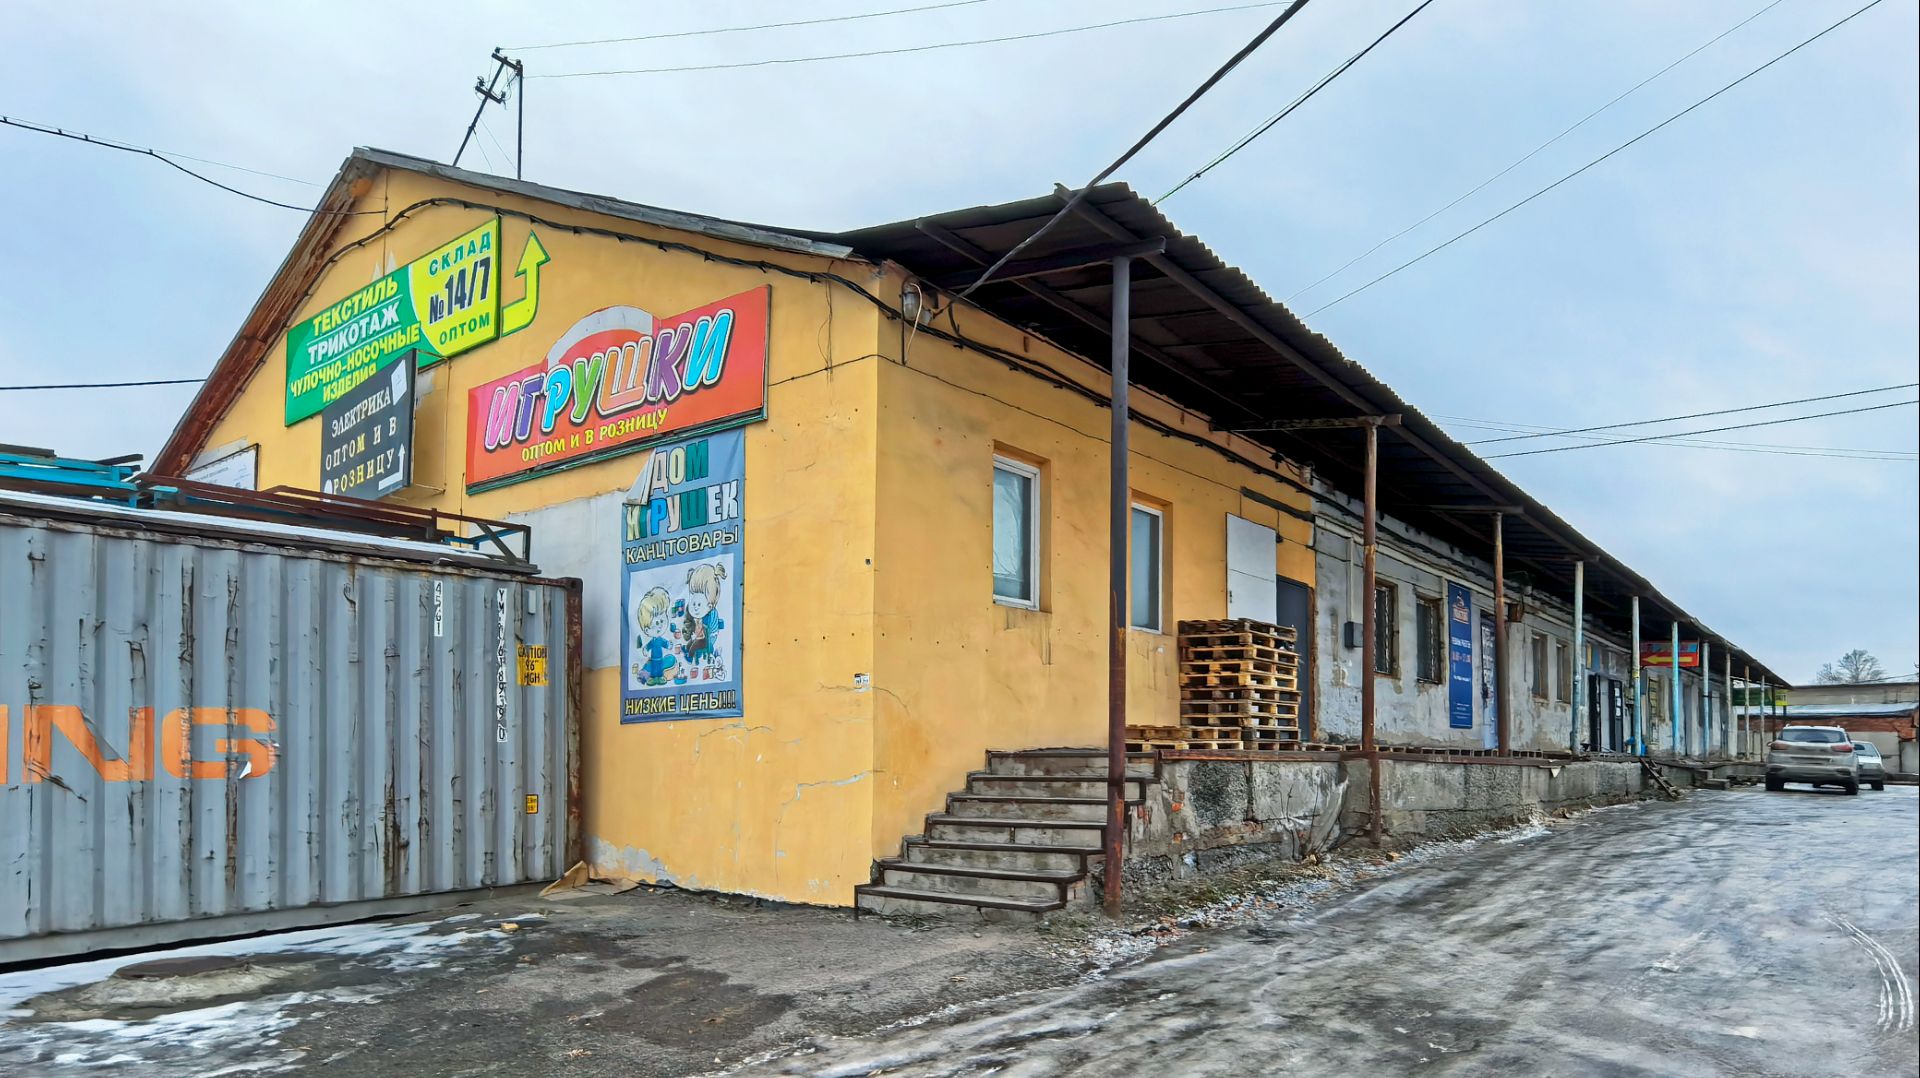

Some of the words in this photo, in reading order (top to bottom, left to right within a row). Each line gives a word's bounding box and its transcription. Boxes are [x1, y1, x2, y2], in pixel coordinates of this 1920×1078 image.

[429, 231, 491, 276] СКЛАД
[312, 276, 399, 337] ТЕКСТИЛЬ
[429, 255, 491, 325] №14/7
[307, 301, 400, 365] ТРИКОТАЖ
[439, 311, 490, 346] ОПТОМ
[290, 320, 421, 398] ЧУЛОЧНО-НОСОЧНЫЕ
[485, 308, 734, 451] ИГРУШКИ
[331, 385, 392, 438] ЭЛЕКТРИКА
[521, 438, 566, 463] ОПТОМ
[570, 432, 580, 449] И
[585, 429, 595, 445] В
[599, 408, 669, 441] РОЗНИЦУ
[325, 432, 366, 471] ОПТОМ
[372, 424, 382, 446] И
[388, 415, 397, 437] В
[651, 438, 709, 493] ДОМ
[333, 447, 395, 496] РОЗНИЦУ
[626, 525, 739, 565] КАНЦТОВАРЫ
[624, 694, 676, 716] НИЗКИЕ
[679, 689, 737, 718] ЦЕНЫ!!!
